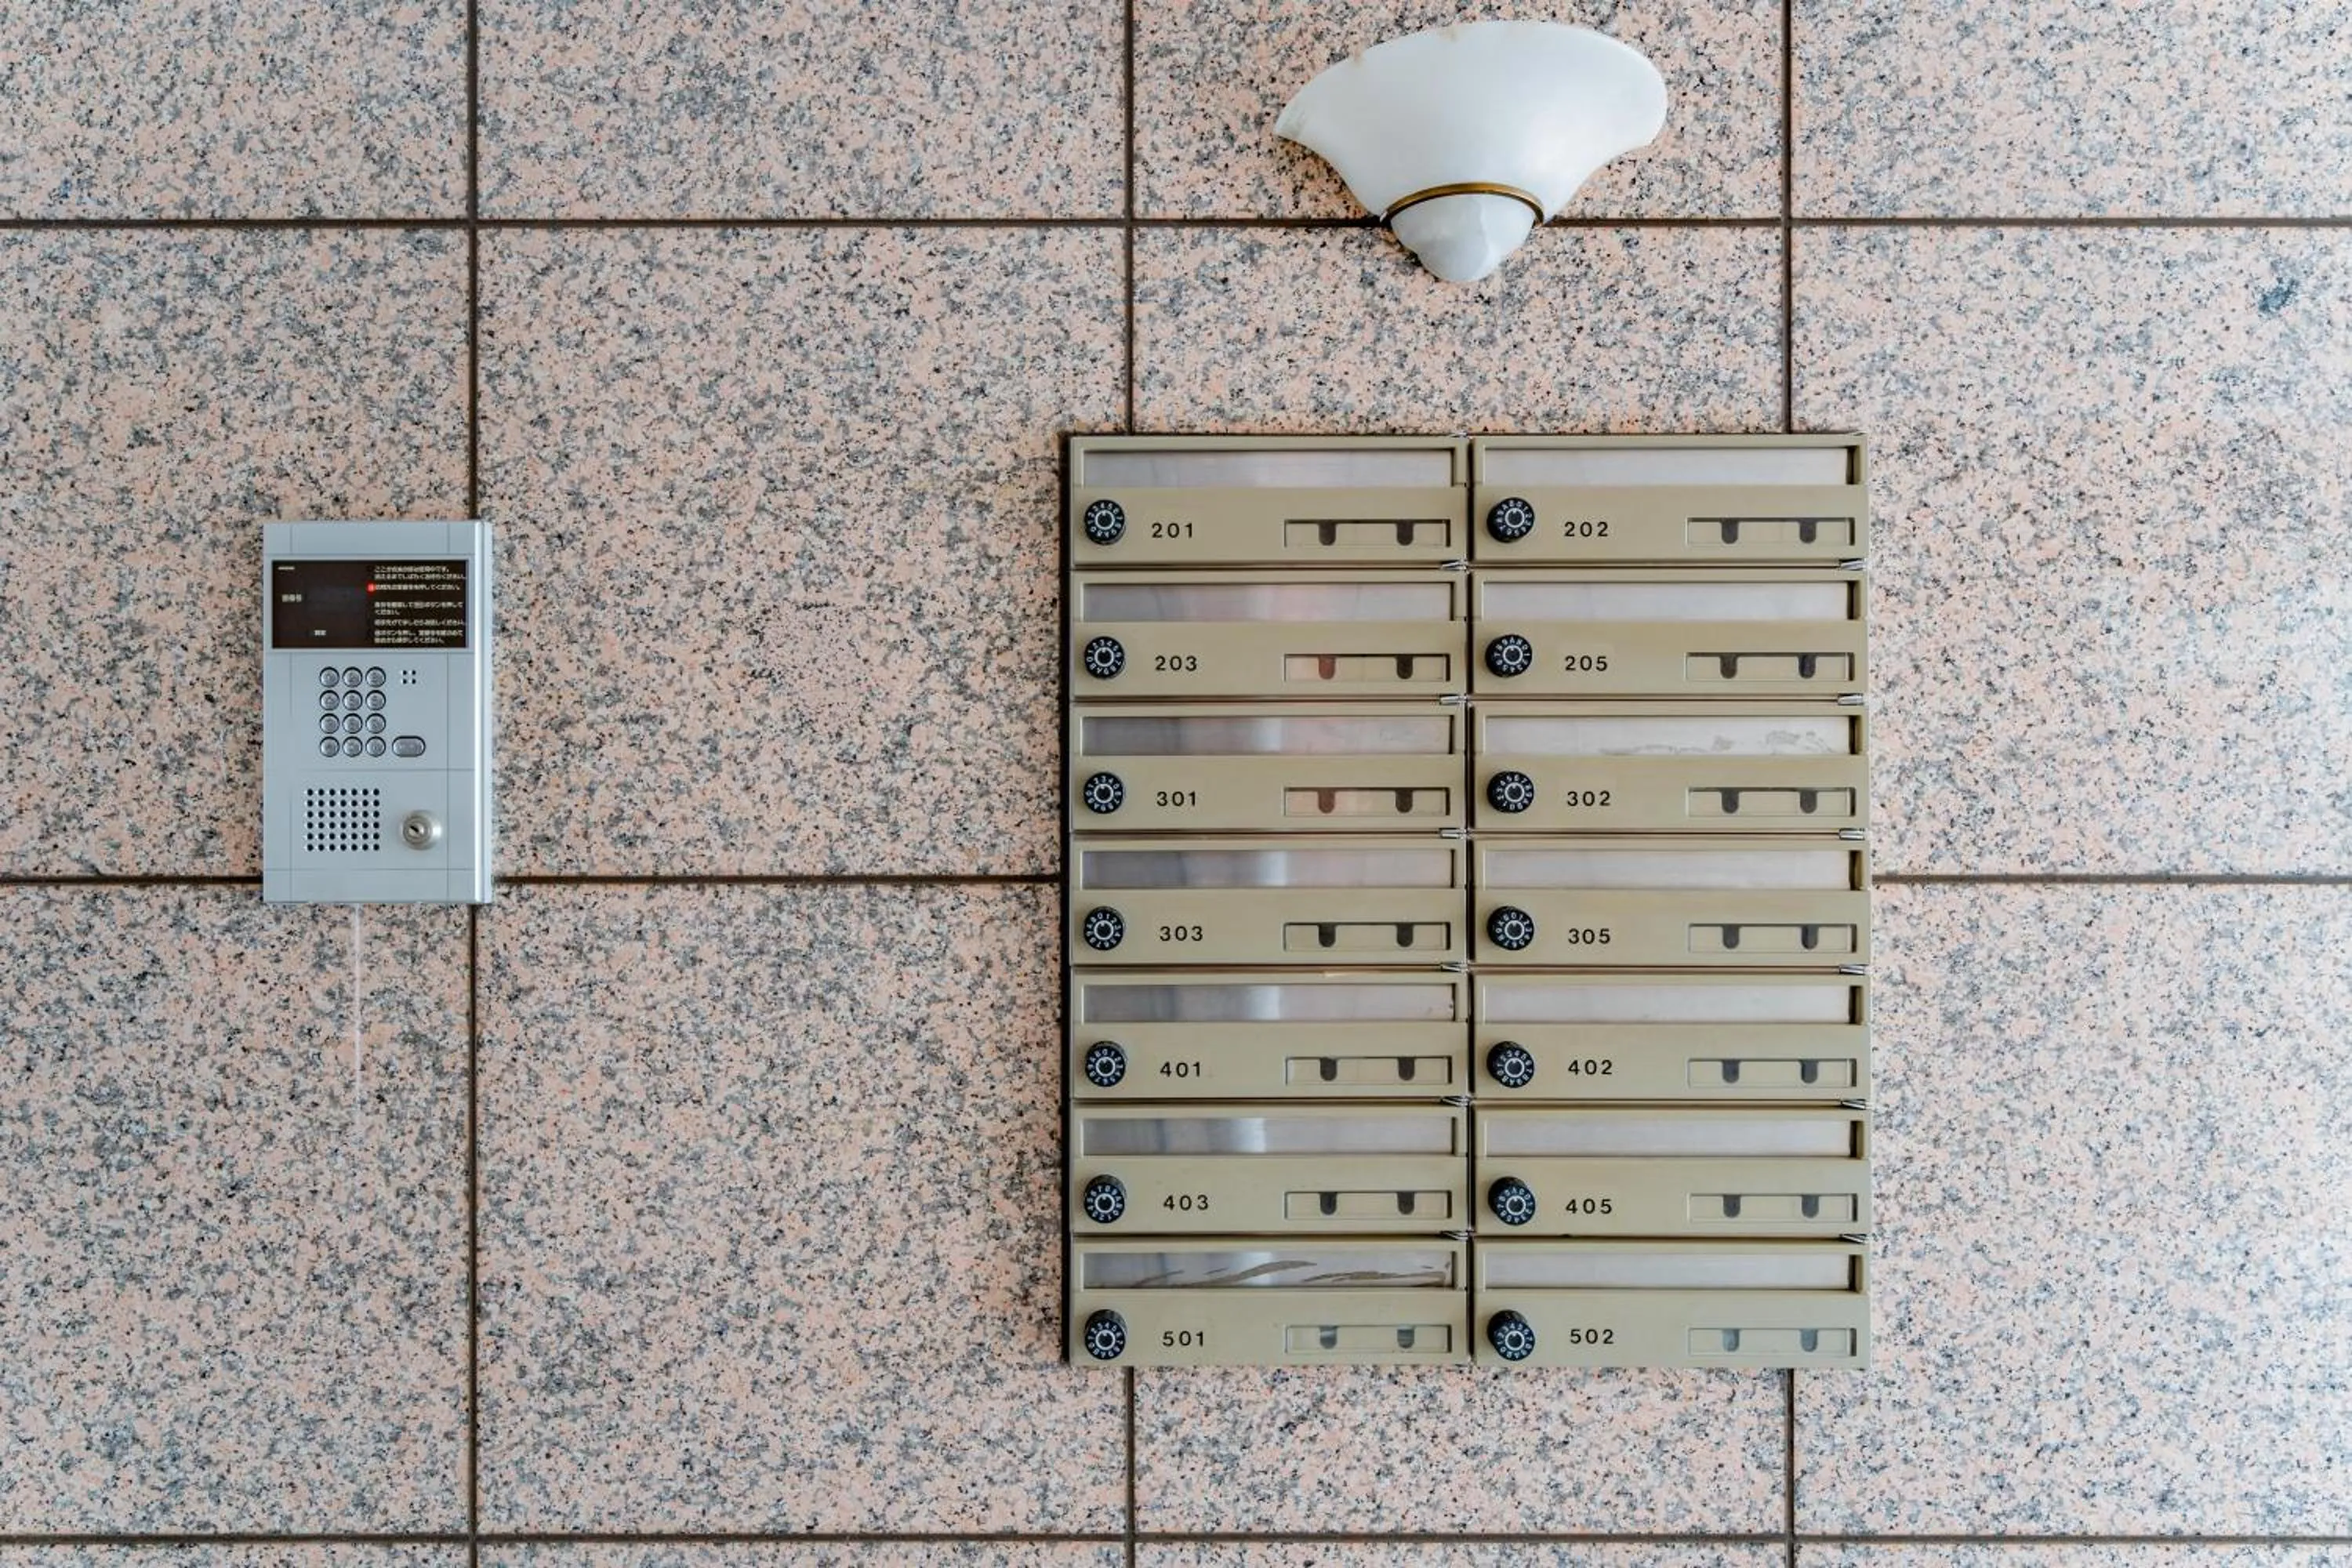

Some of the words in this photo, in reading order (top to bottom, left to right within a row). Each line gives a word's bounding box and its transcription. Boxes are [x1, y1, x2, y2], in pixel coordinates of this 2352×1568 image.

[1151, 522, 1192, 539] 201
[1564, 521, 1609, 538] 202
[1155, 655, 1197, 672] 203
[1564, 655, 1608, 672] 205
[1156, 790, 1196, 808] 301
[1566, 789, 1610, 807] 302
[1160, 925, 1203, 942] 303
[1567, 927, 1611, 945] 305
[1160, 1061, 1200, 1078] 401
[1567, 1059, 1613, 1076] 402
[1163, 1194, 1209, 1211] 403
[1565, 1197, 1613, 1214] 405
[1162, 1330, 1203, 1348] 501
[1570, 1328, 1614, 1345] 502
